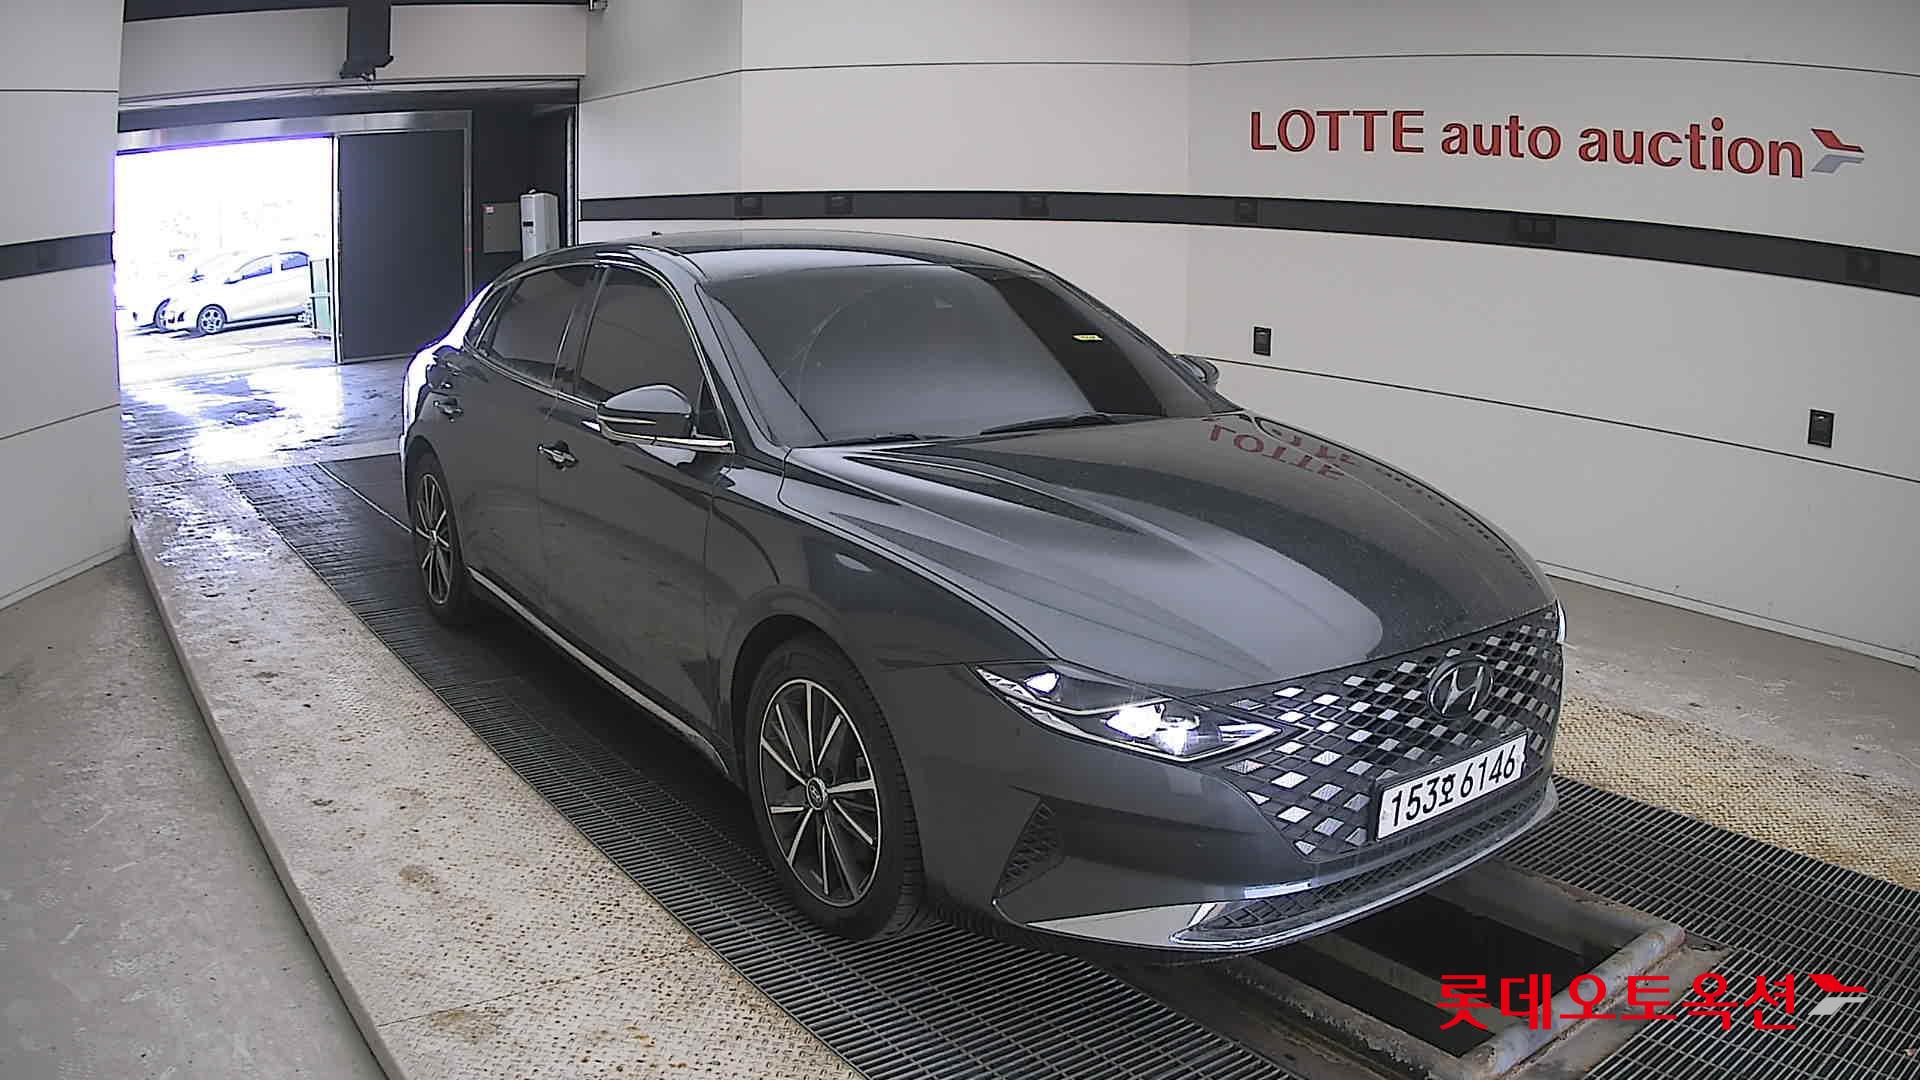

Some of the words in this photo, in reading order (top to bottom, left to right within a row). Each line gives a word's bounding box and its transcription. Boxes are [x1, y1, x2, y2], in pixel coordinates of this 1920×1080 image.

[1250, 110, 1425, 154] LOTTE
[1440, 115, 1562, 160] auto
[1577, 117, 1804, 178] auction
